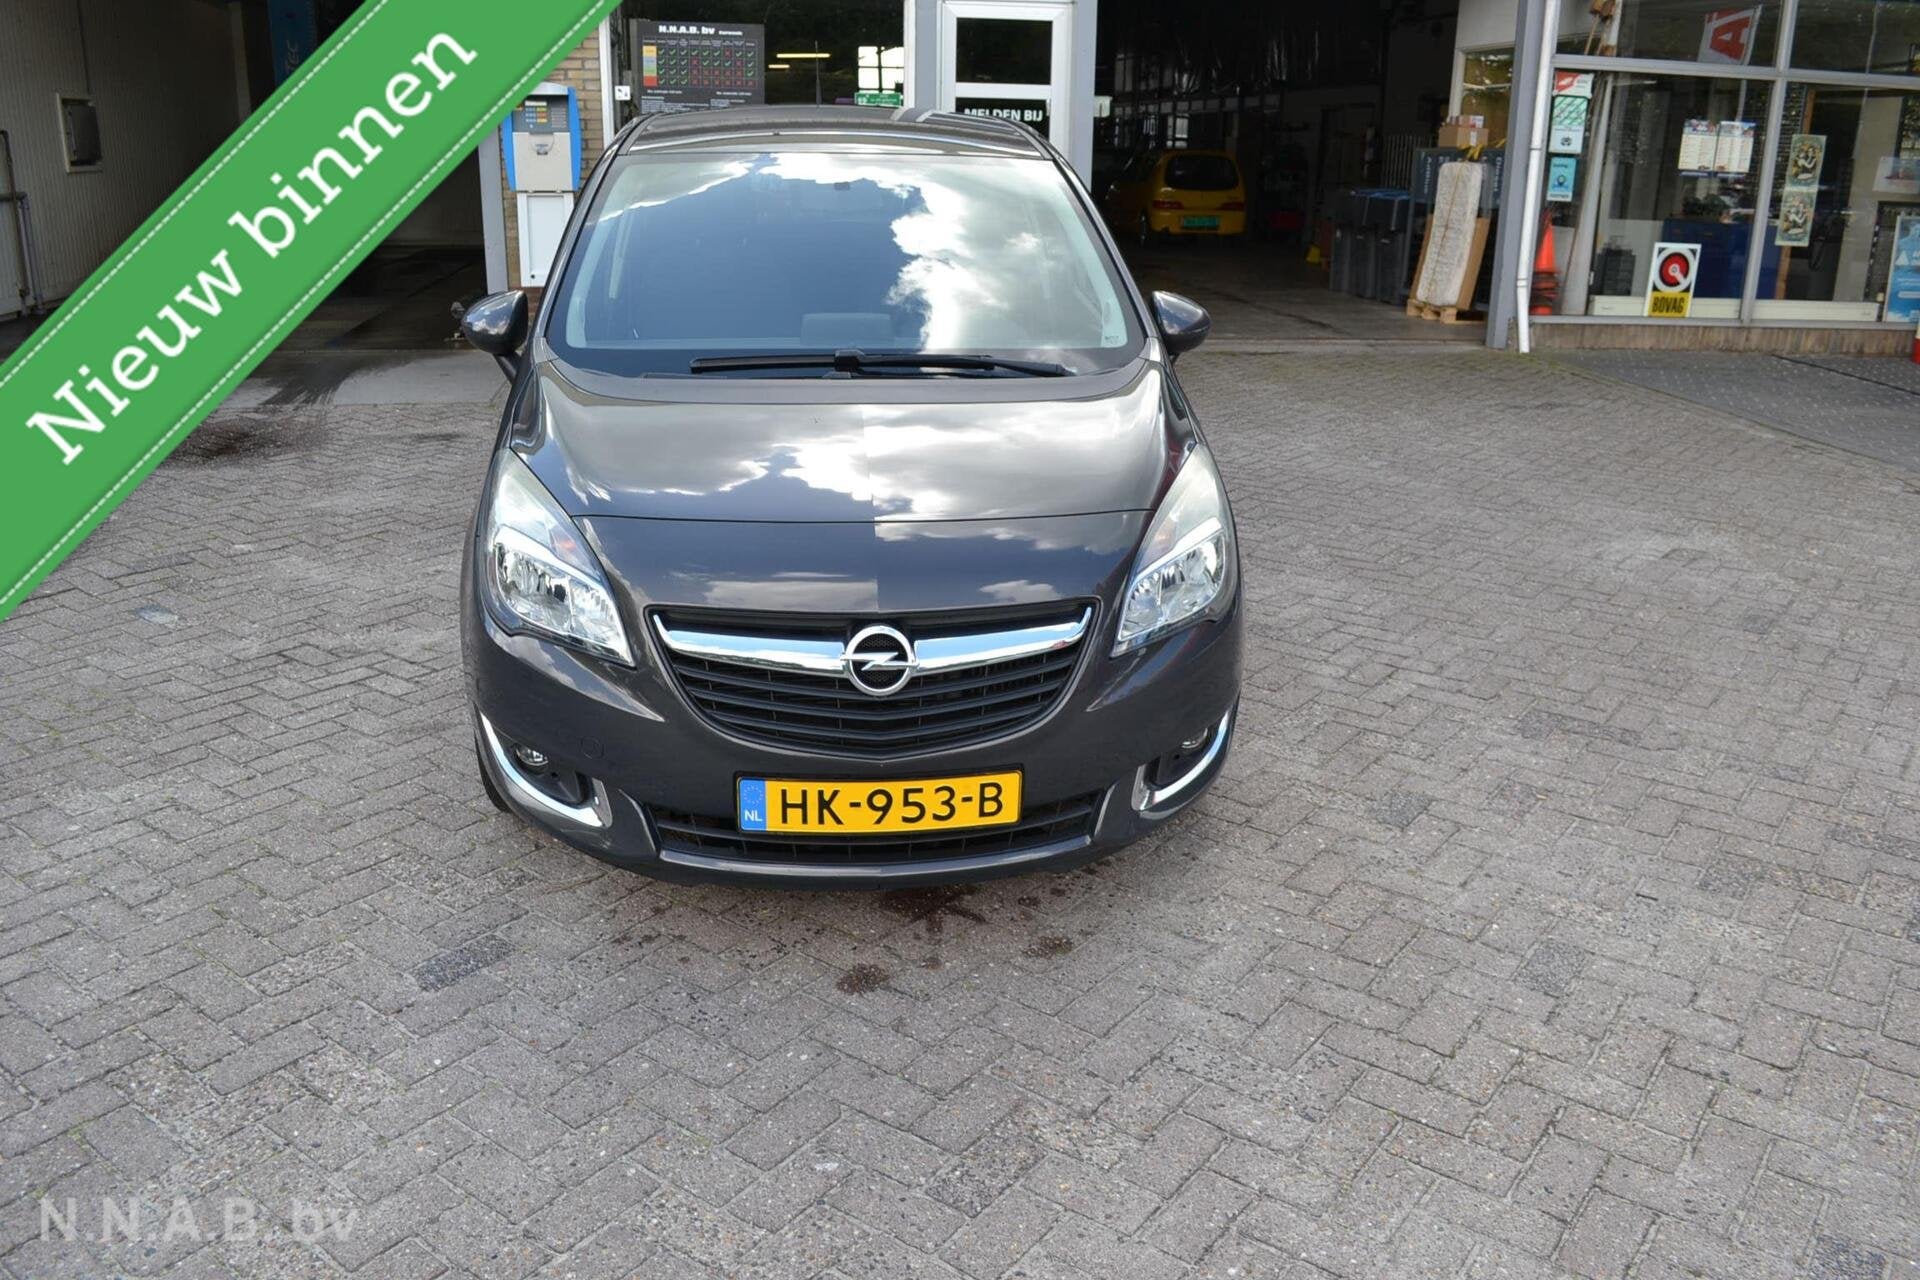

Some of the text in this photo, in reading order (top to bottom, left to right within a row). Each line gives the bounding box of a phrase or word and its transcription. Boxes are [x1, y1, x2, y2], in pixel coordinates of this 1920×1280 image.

[1023, 109, 1043, 122] BIJ
[1651, 296, 1685, 313] BOVAG
[744, 782, 1004, 825] NL HK-953-B
